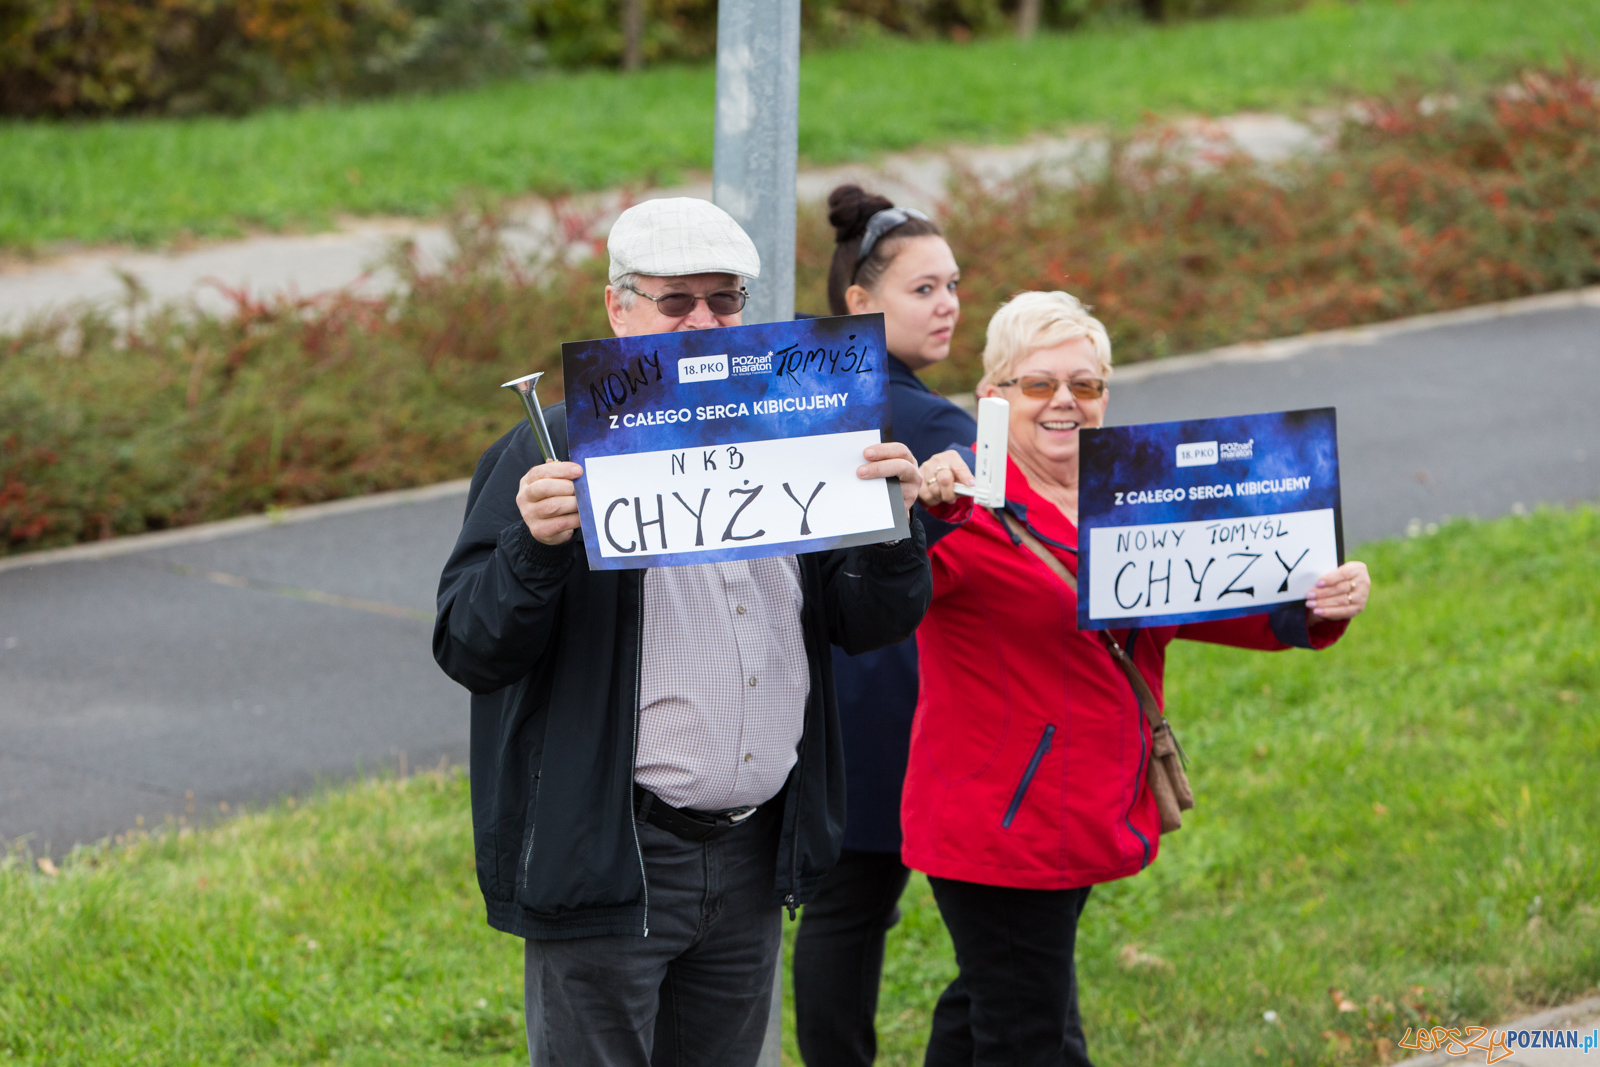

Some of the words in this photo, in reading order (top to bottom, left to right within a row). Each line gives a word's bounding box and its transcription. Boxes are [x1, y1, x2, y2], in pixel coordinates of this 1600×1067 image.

[590, 350, 662, 419] NOWY
[683, 365, 699, 375] 18.
[700, 362, 724, 374] PKO
[732, 362, 772, 374] maraton
[609, 415, 619, 429] Z
[623, 408, 692, 427] CAŁEGO
[696, 403, 750, 420] SERCA
[753, 392, 849, 415] KIBICUJEMY
[1115, 492, 1124, 505] Z
[1126, 487, 1186, 505] CAŁEGO
[1188, 482, 1234, 500] SERCA
[1236, 476, 1311, 496] KIBICUJEMY
[604, 479, 826, 554] CHYŻY
[1117, 529, 1185, 553] NOWY
[1206, 517, 1289, 545] TOMYŚL
[1114, 546, 1310, 610] CHYŻY
